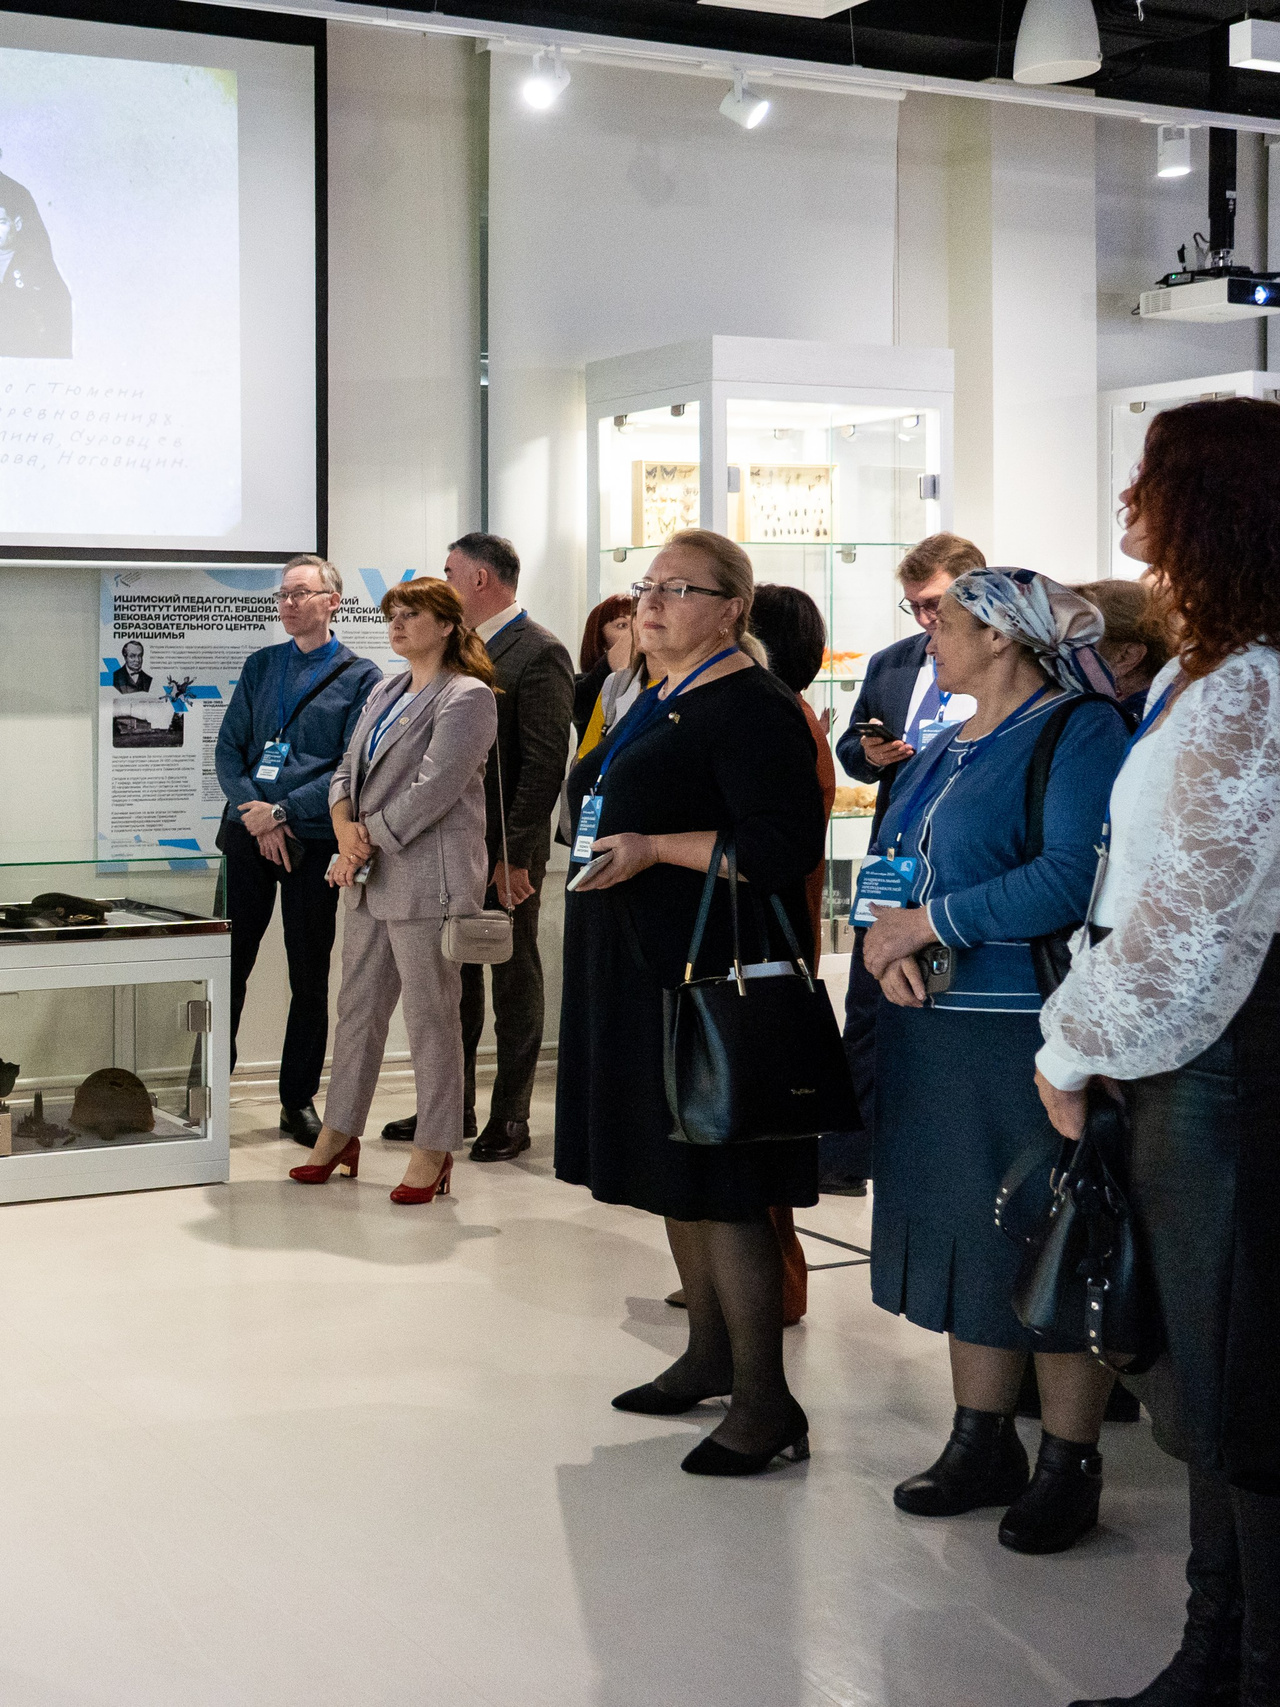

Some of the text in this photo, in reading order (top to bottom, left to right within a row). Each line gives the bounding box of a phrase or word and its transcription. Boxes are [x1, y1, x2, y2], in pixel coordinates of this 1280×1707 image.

[47, 381, 145, 400] Тюмени
[113, 594, 180, 604] ИШИМСКИЙ
[113, 604, 278, 613] ИНСТИТУТ ИМЕНИ П.П. ЕРШОВА
[337, 605, 383, 614] ИЧЕСКИЙ
[113, 613, 160, 621] ВЕКОВАЯ
[162, 614, 209, 622] ИСТОРИЯ
[341, 615, 351, 623] И.
[353, 615, 387, 624] МЕНДЕ
[113, 622, 266, 632] ОБРАЗОВАТЕЛЬНОГО ЦЕНТРА
[113, 631, 185, 639] ПРИИШИМЬЯ
